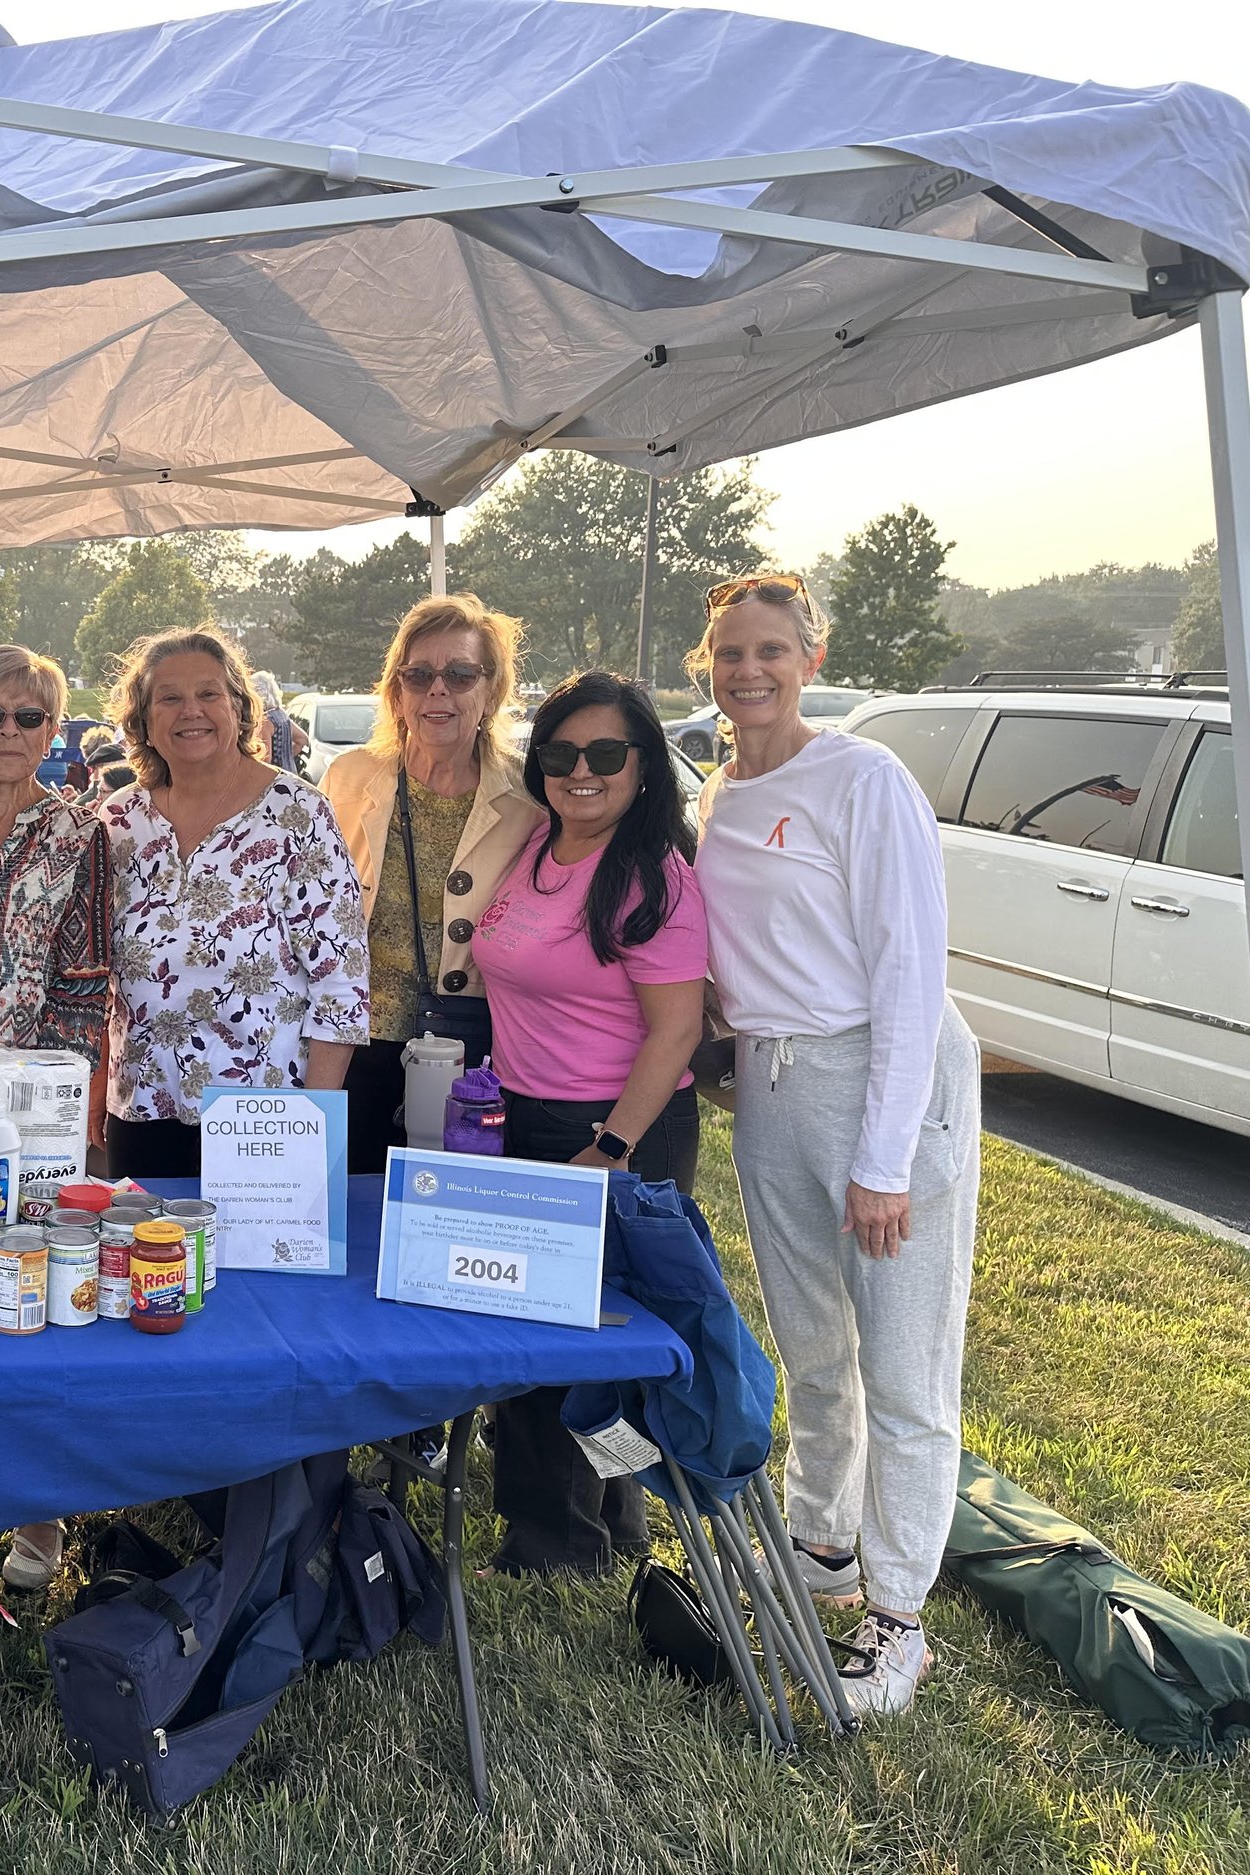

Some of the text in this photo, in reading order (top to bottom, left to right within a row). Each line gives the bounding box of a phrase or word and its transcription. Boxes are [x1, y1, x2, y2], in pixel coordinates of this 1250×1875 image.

[1192, 1012, 1250, 1031] CHRY
[236, 1100, 286, 1114] FOOD
[206, 1121, 319, 1135] COLLECTION
[237, 1142, 285, 1157] HERE
[19, 1165, 76, 1183] everyda
[446, 1182, 578, 1206] Illinois Liquor Control Commission
[495, 1222, 520, 1230] PROOF
[295, 1253, 311, 1261] Club
[455, 1256, 518, 1283] 2004
[416, 1281, 446, 1291] ILLEGAL
